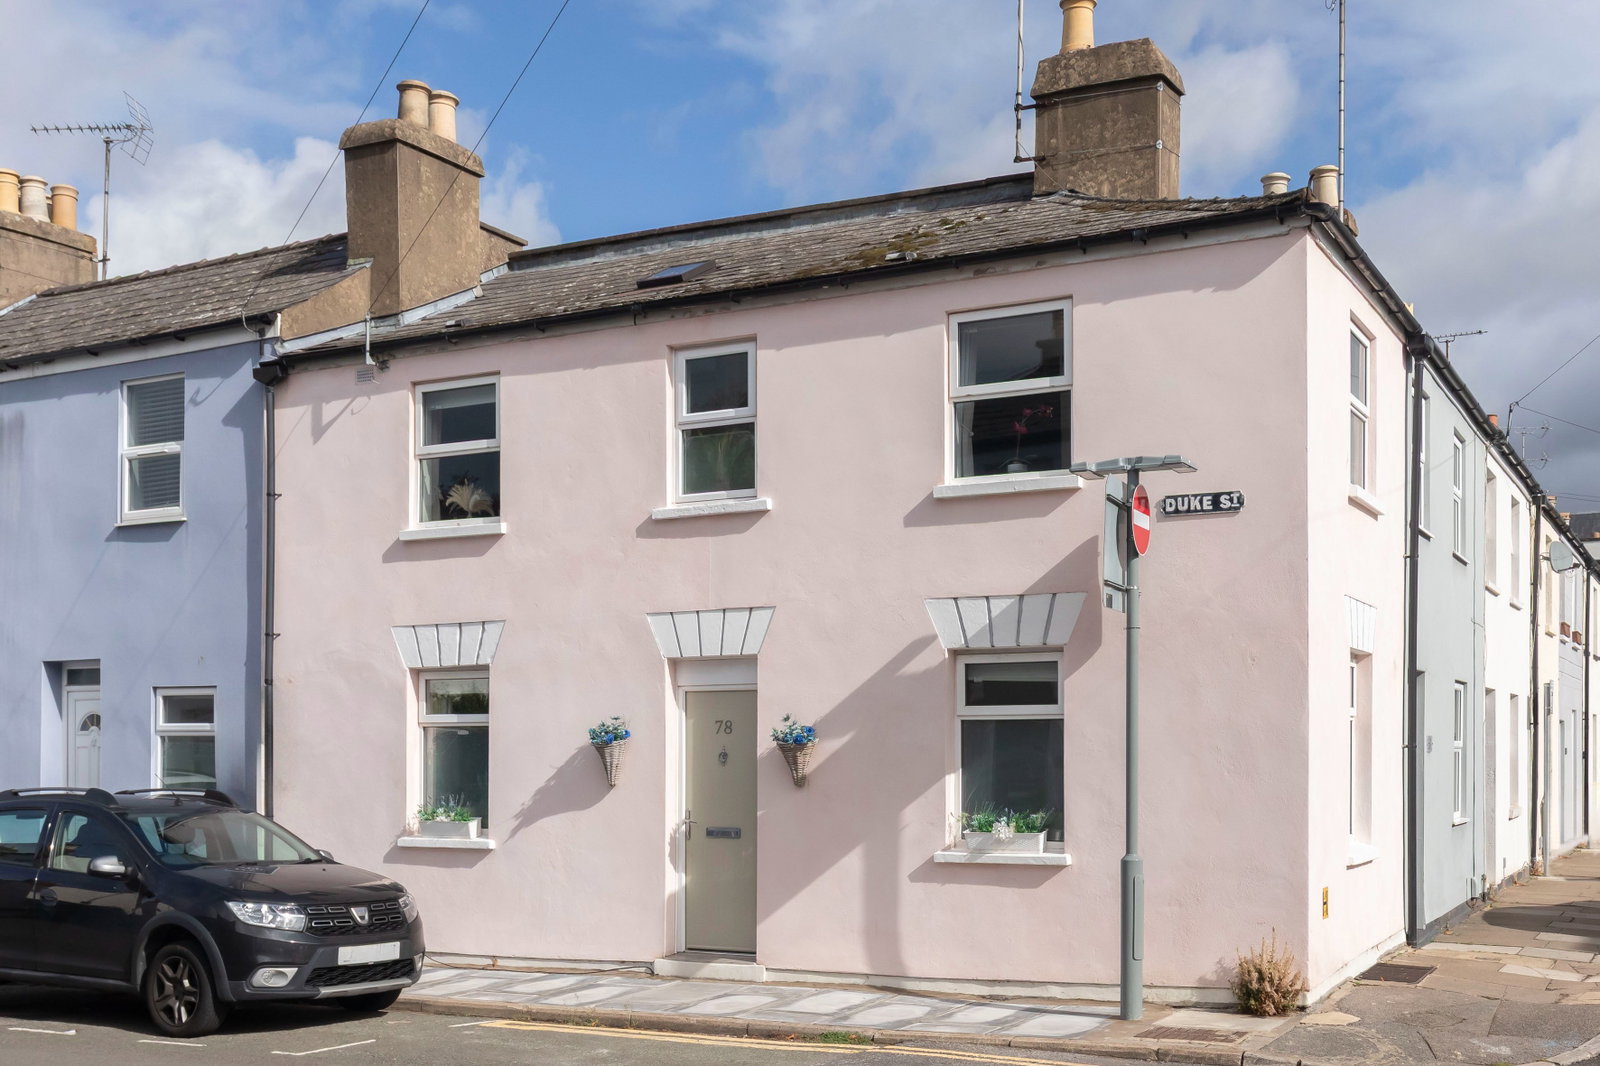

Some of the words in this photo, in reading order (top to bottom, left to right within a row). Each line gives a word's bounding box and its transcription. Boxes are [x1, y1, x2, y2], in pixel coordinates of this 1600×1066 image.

[1165, 494, 1213, 512] DUKE
[1219, 493, 1240, 509] ST
[714, 719, 733, 735] 78
